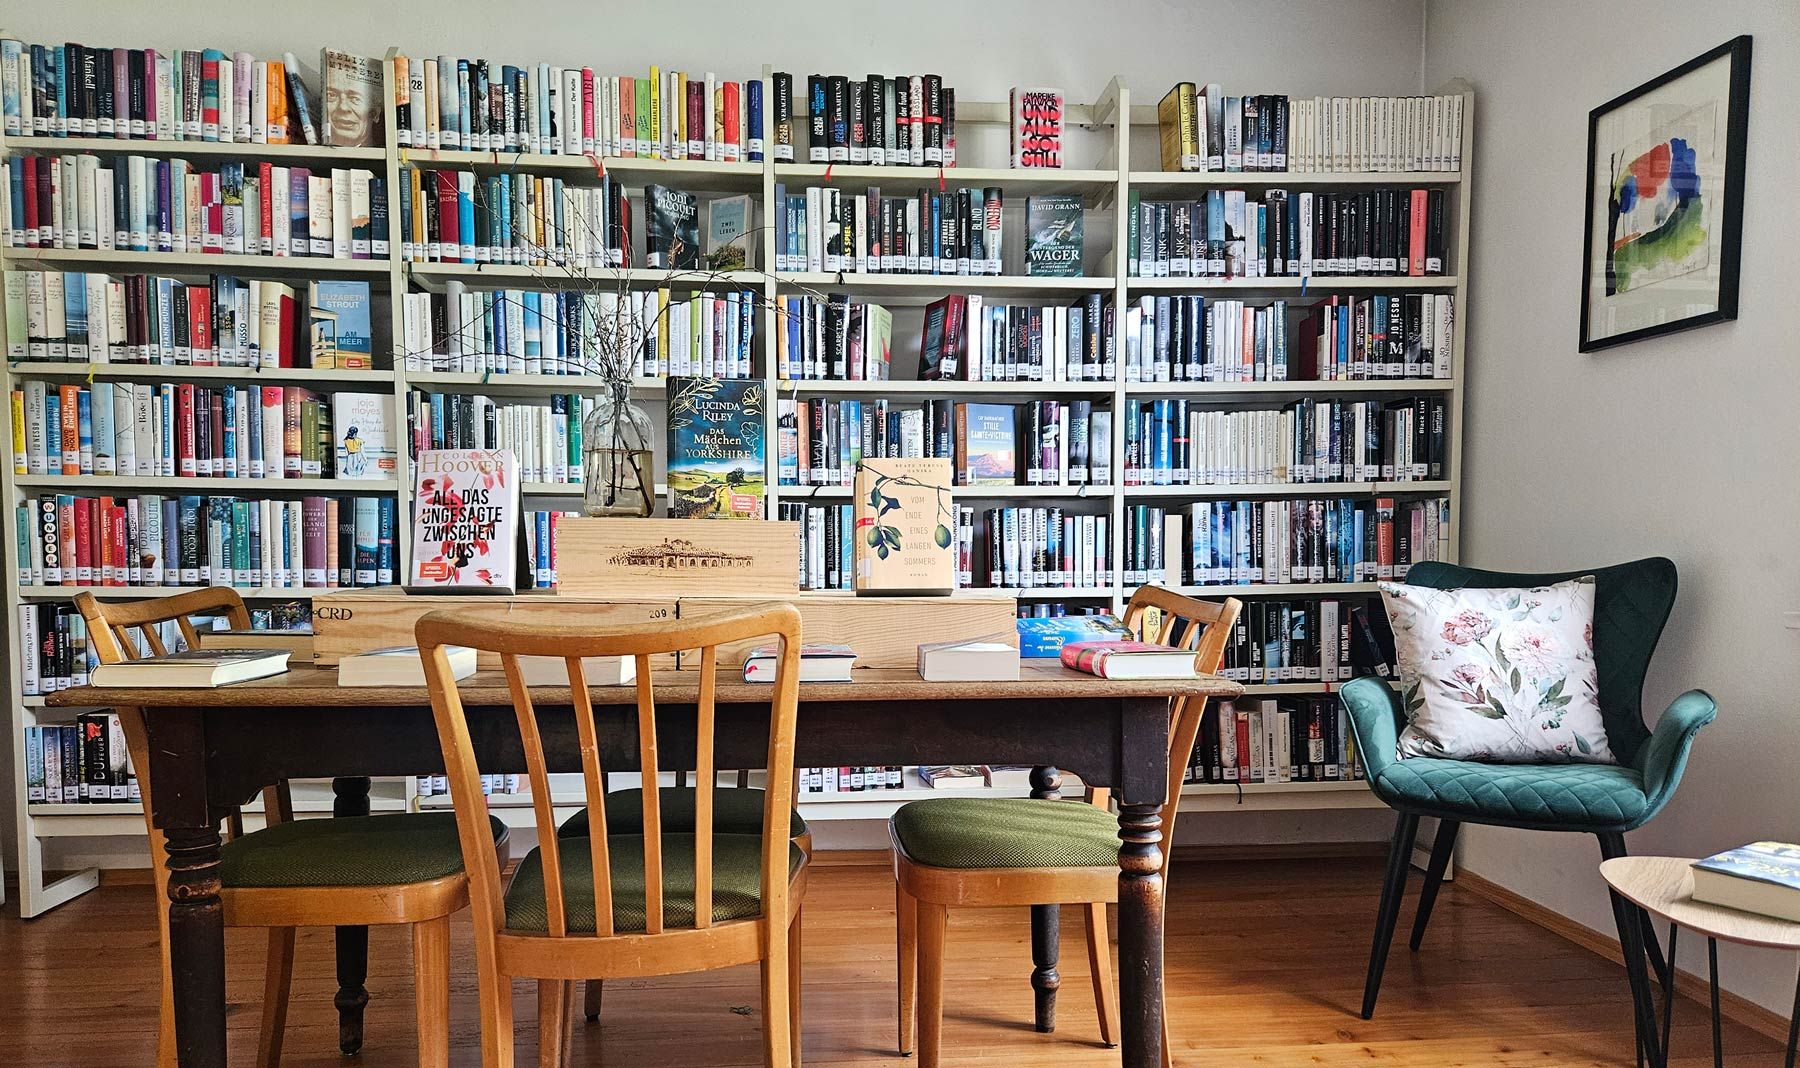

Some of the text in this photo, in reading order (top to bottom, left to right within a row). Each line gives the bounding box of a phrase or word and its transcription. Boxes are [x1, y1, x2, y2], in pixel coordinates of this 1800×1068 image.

[84, 54, 95, 90] Mankell
[411, 79, 423, 91] 28
[1022, 105, 1059, 120] UND
[1022, 121, 1059, 137] ALLE
[1028, 137, 1053, 151] SO
[1021, 151, 1061, 168] STILL
[666, 191, 687, 205] JODI
[657, 199, 697, 217] PICOULT
[971, 208, 982, 231] BLIND
[1030, 249, 1080, 261] WAGER
[1143, 236, 1152, 262] LINK
[1158, 239, 1167, 261] LINK
[162, 293, 170, 323] MÜNZER
[1072, 316, 1080, 339] ZERO
[1391, 324, 1399, 335] JO
[352, 407, 381, 416] moyes
[695, 398, 741, 411] LUCINDA
[702, 410, 734, 423] RILEY
[983, 422, 999, 431] STILLE
[694, 433, 742, 445] Mädchen
[863, 412, 872, 458] SOMMERNACHT
[685, 449, 751, 460] YORKSHIRE
[421, 453, 505, 473] HOOVER
[432, 488, 489, 506] ALL DAS
[911, 496, 926, 504] VOM
[149, 502, 159, 542] PICOULT
[422, 507, 503, 524] UNGESAGTE
[140, 529, 148, 551] JODI
[188, 507, 197, 565] JODI PICOULT
[423, 525, 496, 542] ZWISCHEN
[447, 543, 475, 559] UNS
[905, 542, 932, 550] LANGEN
[903, 558, 936, 566] SOMMERS
[317, 606, 353, 621] CRD
[649, 608, 667, 619] 209
[26, 632, 34, 671] Mädchengrab
[95, 762, 105, 780] DU
